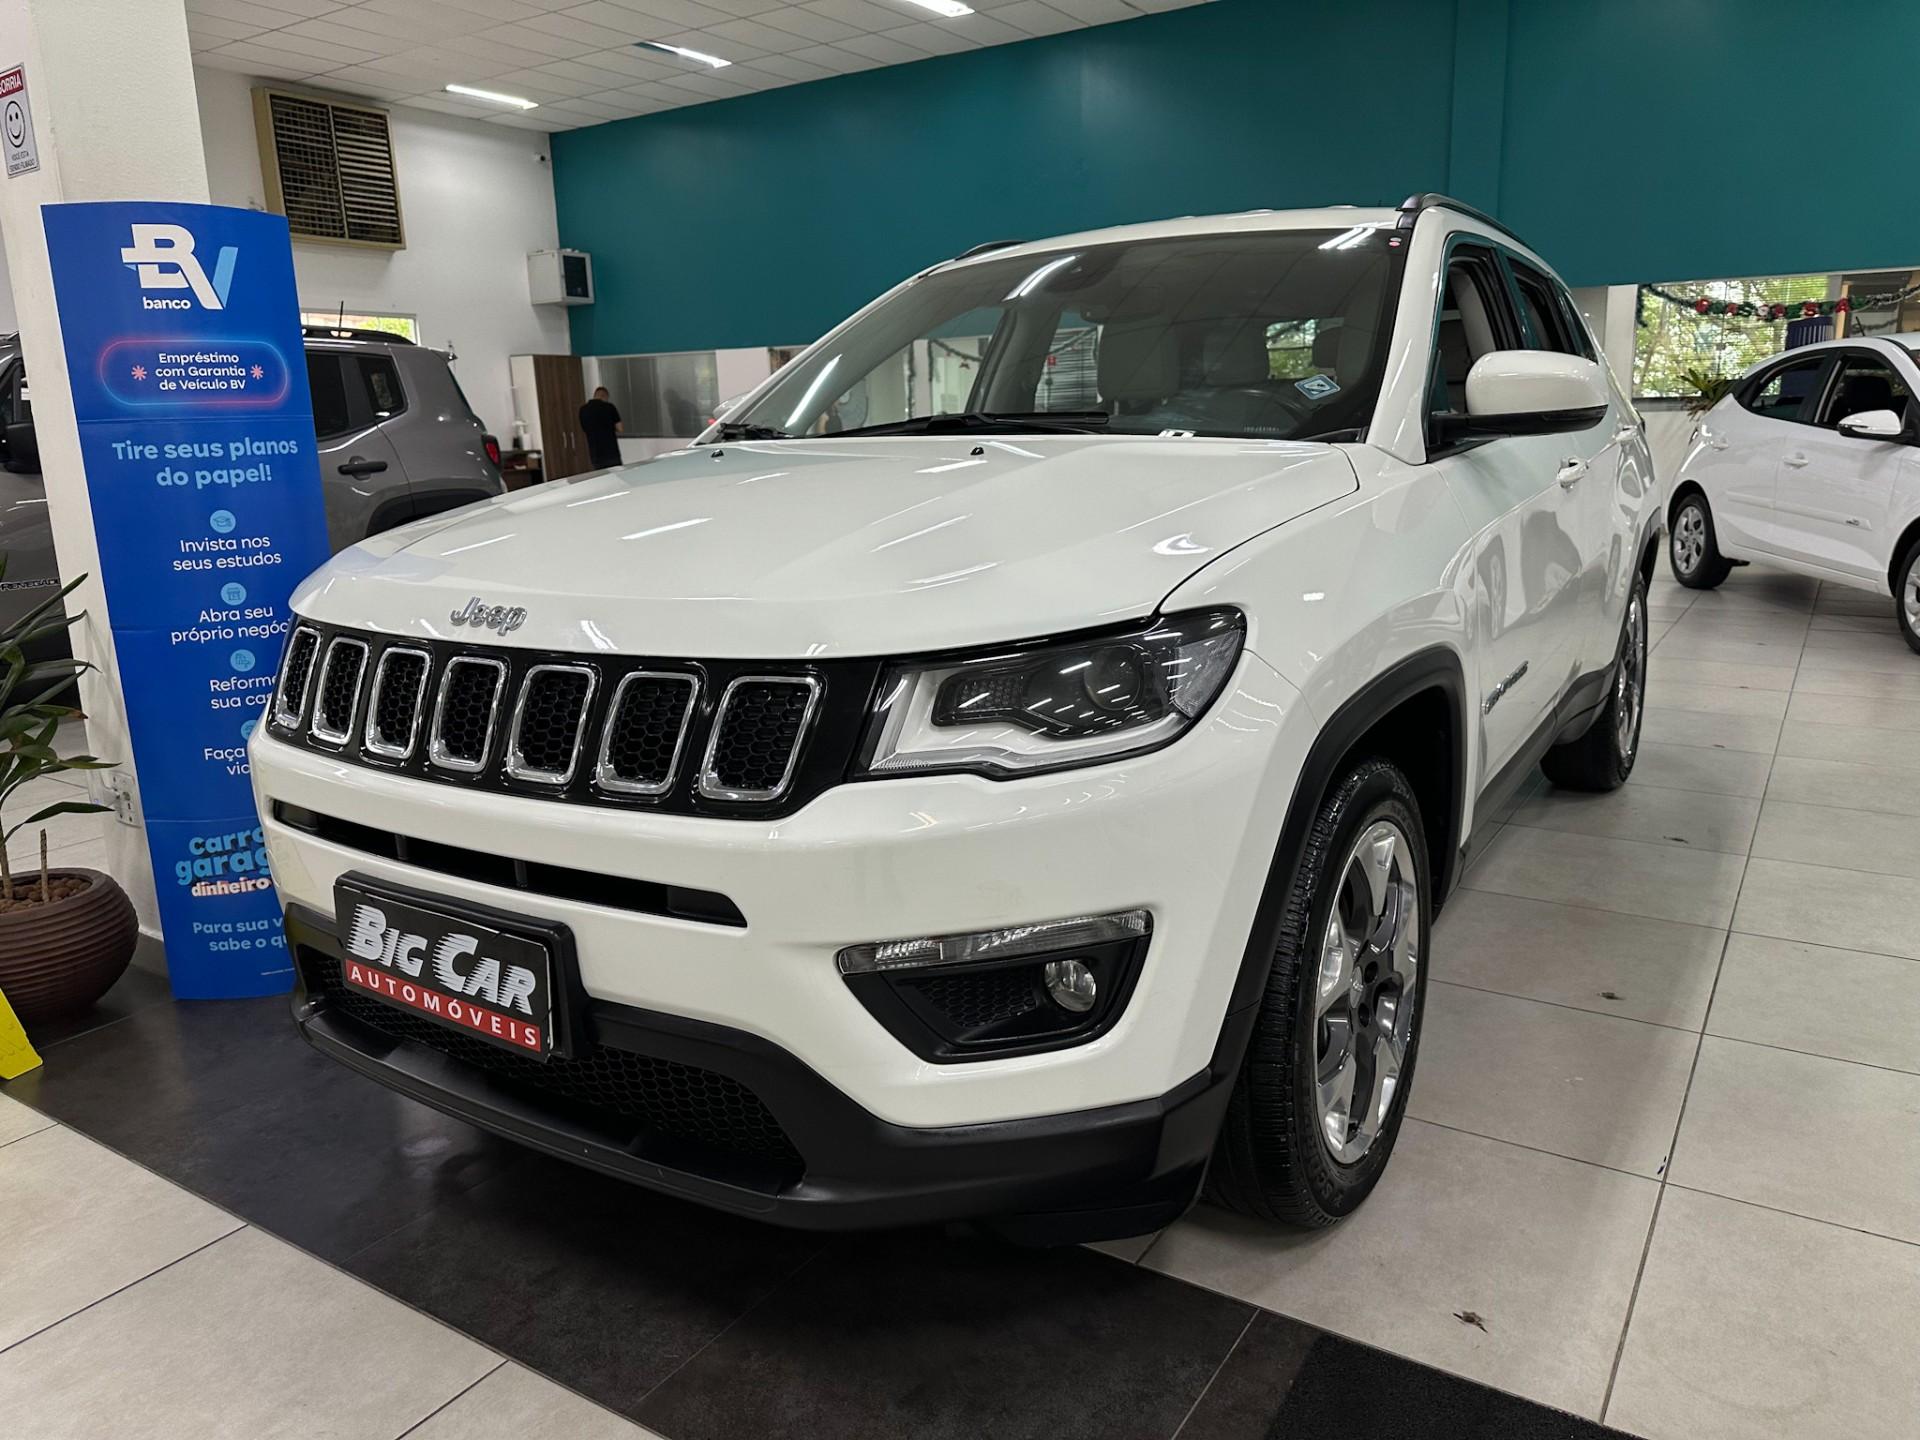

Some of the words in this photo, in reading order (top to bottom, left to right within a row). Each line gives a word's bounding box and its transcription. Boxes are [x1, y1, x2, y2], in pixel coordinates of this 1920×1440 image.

[0, 73, 21, 95] ORRIA
[143, 297, 191, 310] banco
[159, 352, 239, 366] Empréstimo
[155, 368, 185, 377] com
[188, 365, 246, 377] Garantia
[159, 379, 177, 390] de
[179, 378, 228, 390] Veículo
[230, 379, 246, 390] BV
[112, 440, 159, 460] Tire
[163, 441, 224, 459] seus
[229, 437, 298, 461] planos
[156, 466, 189, 486] do
[195, 463, 272, 489] papel!
[180, 537, 237, 553] Invista
[241, 536, 271, 549] nos
[173, 558, 213, 571] seus
[216, 551, 282, 569] estudos
[0, 577, 60, 592] RENEGAD
[199, 608, 240, 623] Abra
[244, 606, 273, 619] seu
[450, 596, 528, 637] Jeep
[171, 626, 234, 646] próprio
[238, 618, 290, 639] negóc
[211, 696, 241, 709] sua
[204, 747, 246, 762] Faça
[191, 876, 271, 897] dinheiro
[192, 921, 233, 934] Para
[236, 919, 269, 932] sua
[209, 937, 251, 951] sabe
[255, 938, 267, 948] o
[347, 903, 428, 977] BIG
[432, 932, 536, 1015] CAR
[350, 966, 537, 1046] AUTOMÓVEIS
